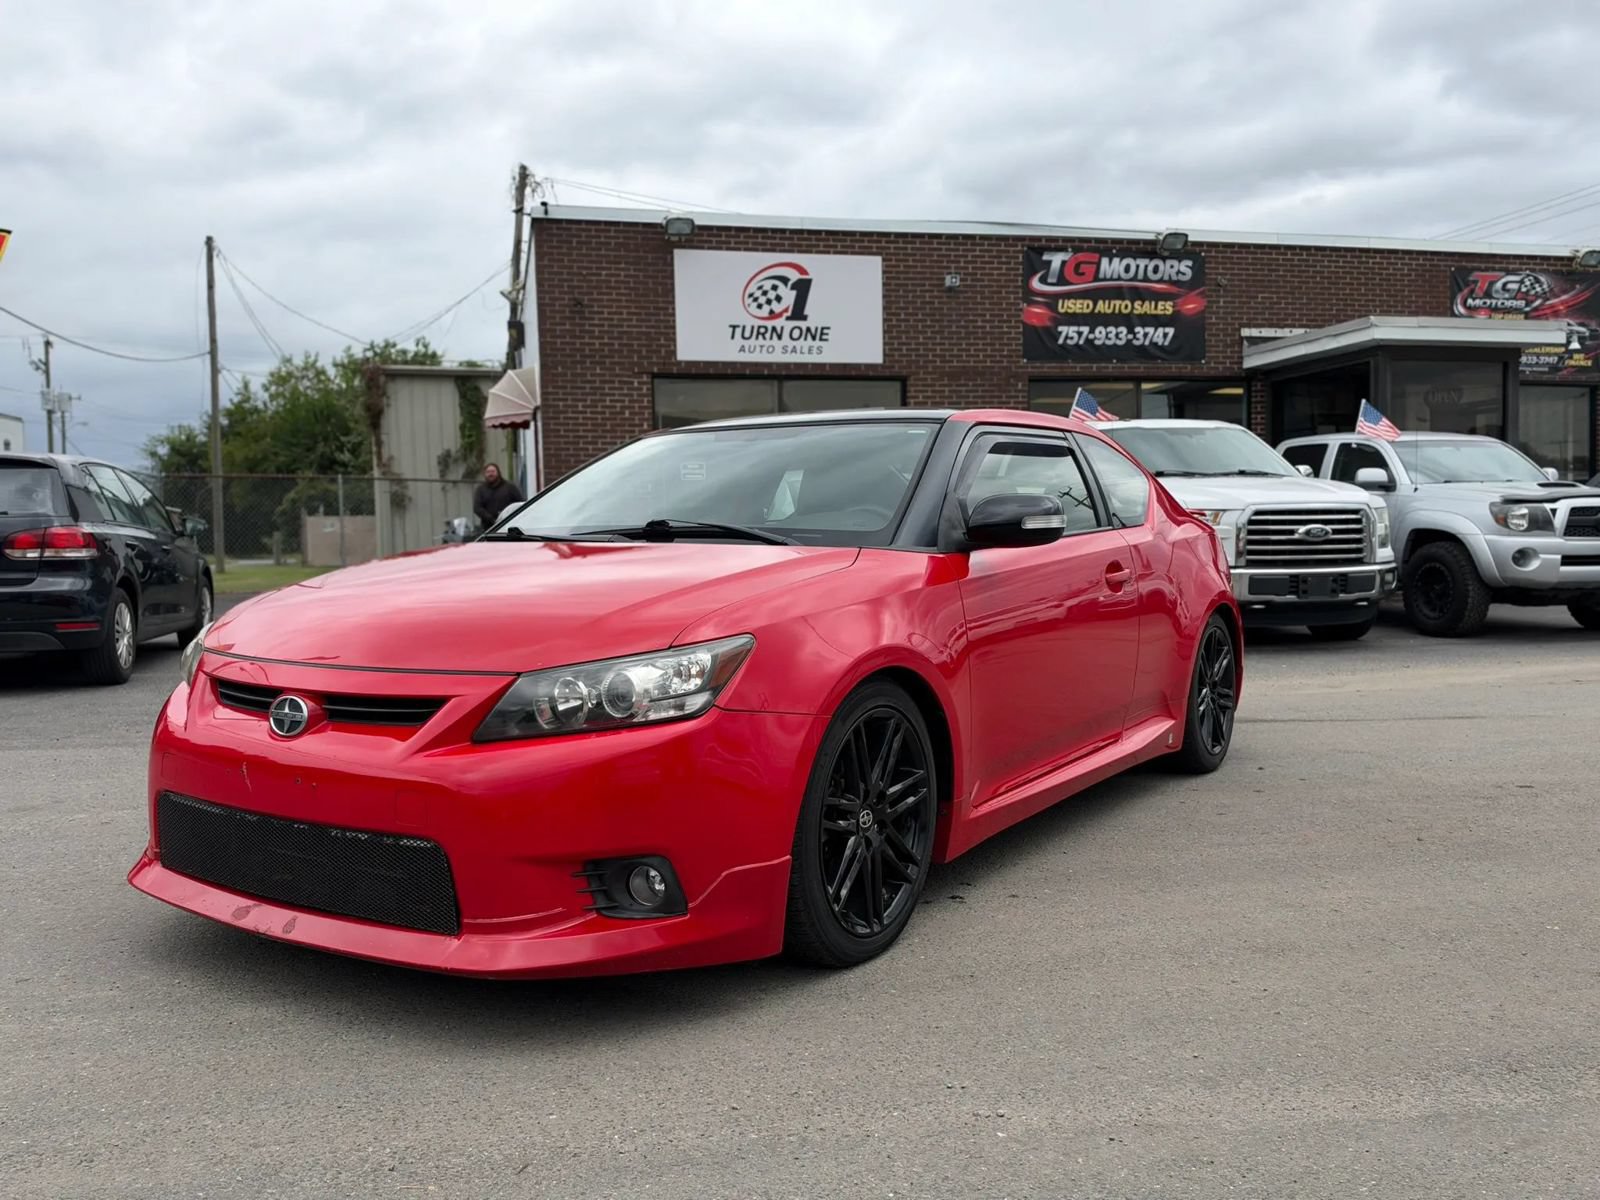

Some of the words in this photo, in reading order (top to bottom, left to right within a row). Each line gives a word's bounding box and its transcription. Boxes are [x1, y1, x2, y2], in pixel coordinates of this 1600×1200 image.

[1041, 251, 1100, 284] TG
[1100, 257, 1194, 282] MOTORS
[1470, 271, 1525, 298] TG
[785, 278, 813, 321] 1
[1057, 299, 1094, 314] USED
[1094, 300, 1132, 314] AUTO
[1133, 301, 1174, 316] SALES
[1466, 298, 1527, 309] MOTORS
[728, 324, 785, 342] TURN
[788, 326, 831, 342] ONE
[1057, 325, 1175, 347] 757-933-3747
[738, 345, 776, 355] AUTO
[781, 346, 824, 356] SALES
